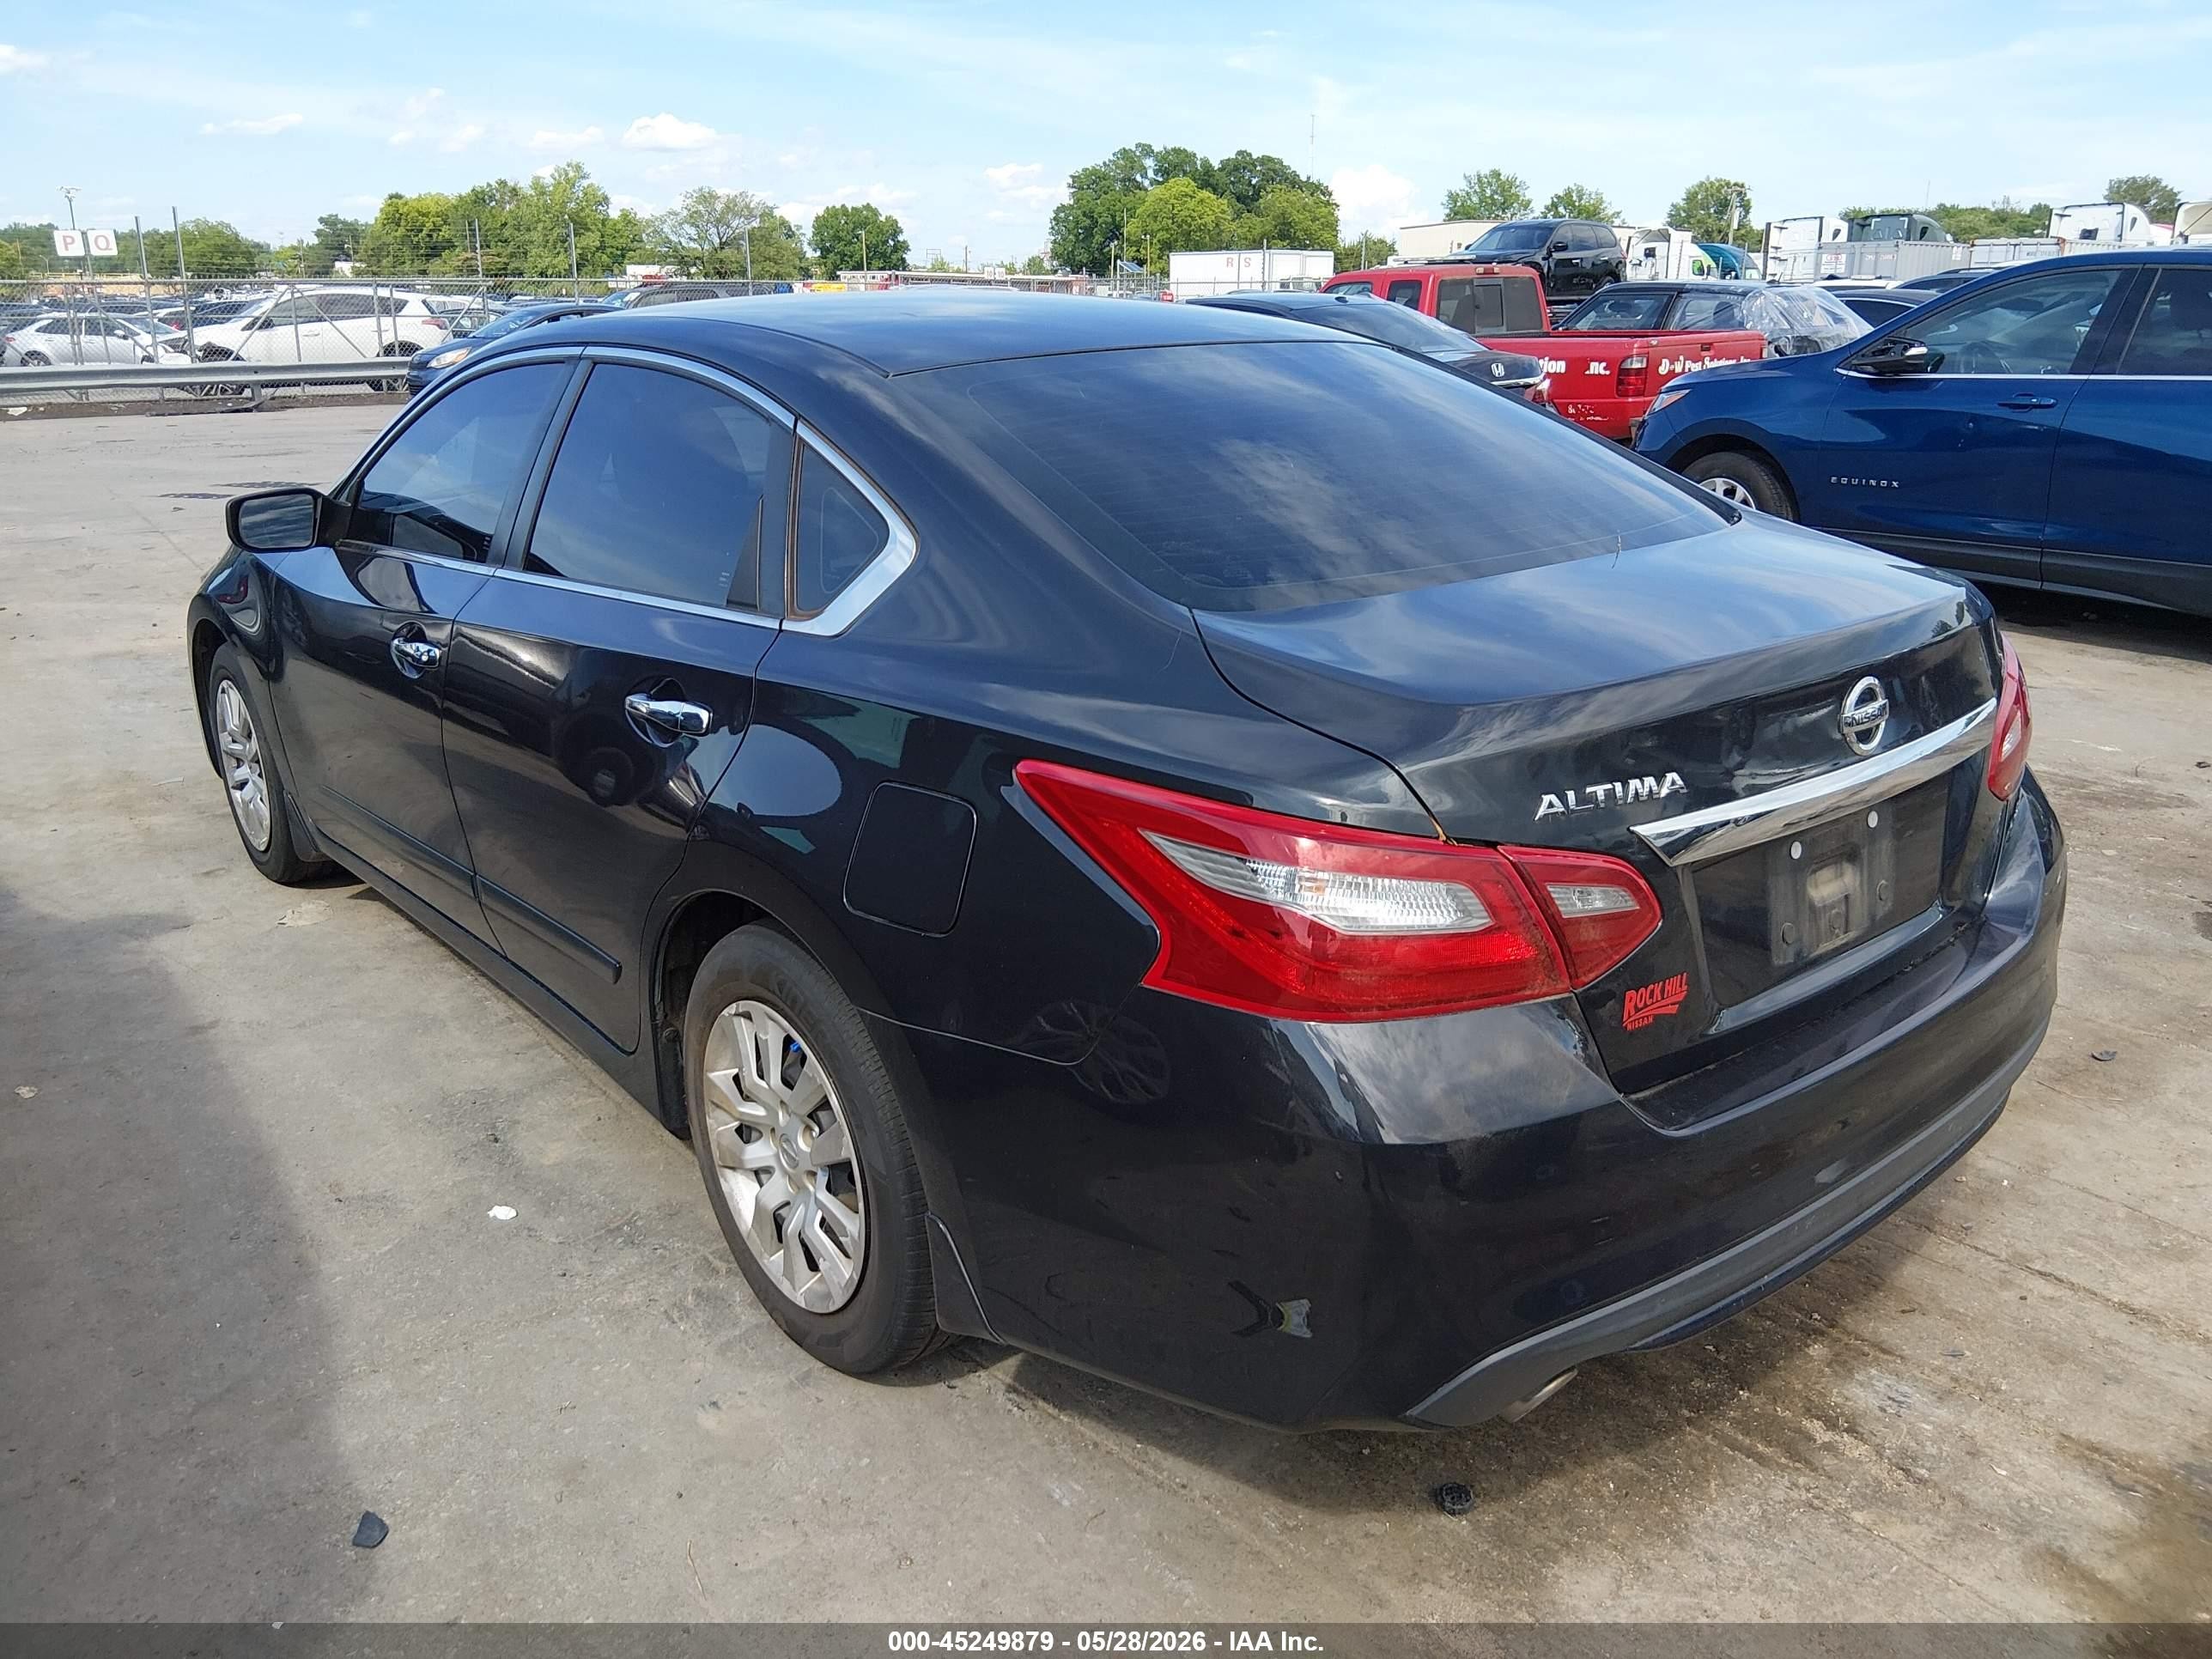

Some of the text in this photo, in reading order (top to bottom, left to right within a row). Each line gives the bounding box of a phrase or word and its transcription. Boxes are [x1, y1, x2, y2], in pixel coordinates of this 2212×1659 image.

[63, 235, 76, 251] P
[94, 234, 112, 251] Q
[1226, 258, 1234, 268] R
[1244, 258, 1251, 268] S
[1830, 477, 1899, 489] EQUINOX
[1850, 702, 1887, 727] NISSAN
[1534, 771, 1689, 822] ALTIMA
[1623, 972, 1688, 1023] ROCK HILL
[1626, 1014, 1654, 1031] NISSAN
